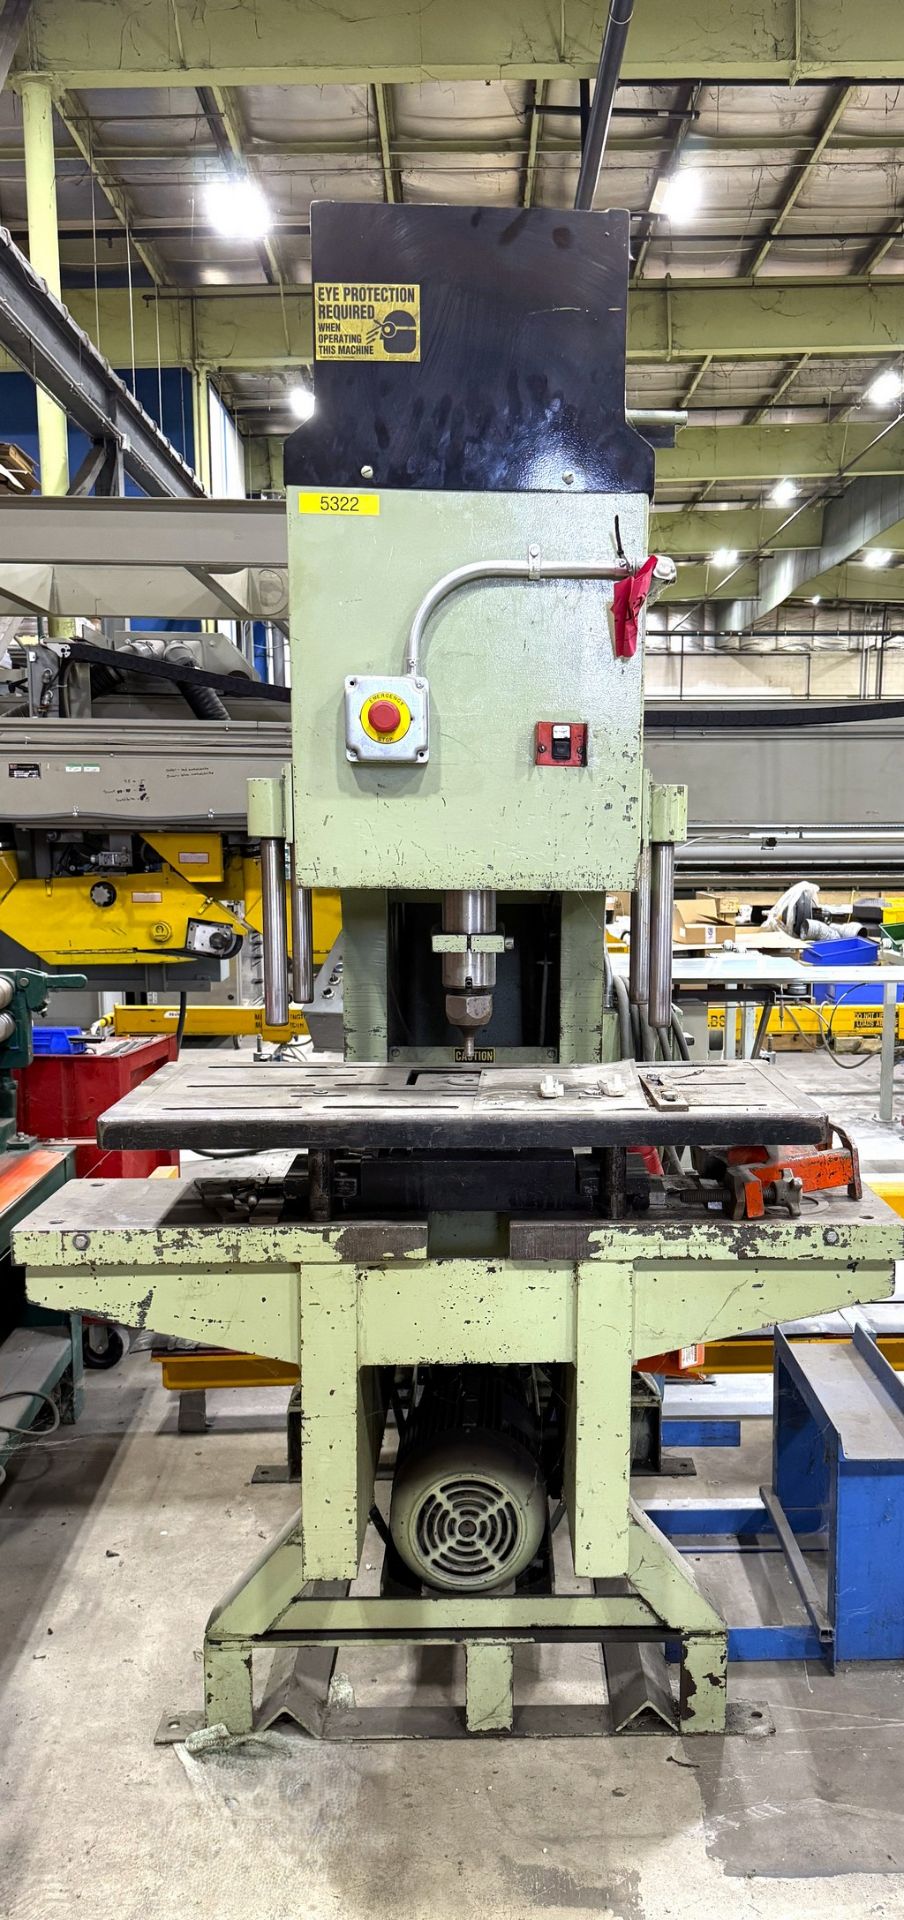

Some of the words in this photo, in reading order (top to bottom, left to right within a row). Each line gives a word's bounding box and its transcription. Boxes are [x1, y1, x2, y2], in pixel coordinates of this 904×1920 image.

[318, 287, 339, 302] EYE
[343, 287, 415, 303] PROTECTION
[318, 304, 375, 320] REQUIRED
[318, 322, 341, 332] WHEN
[318, 334, 362, 344] OPERATING
[318, 345, 336, 355] THIS
[338, 345, 374, 355] MACHINE
[320, 496, 360, 512] 5322
[369, 693, 405, 706] EMERGENCY
[707, 1015, 726, 1028] BS
